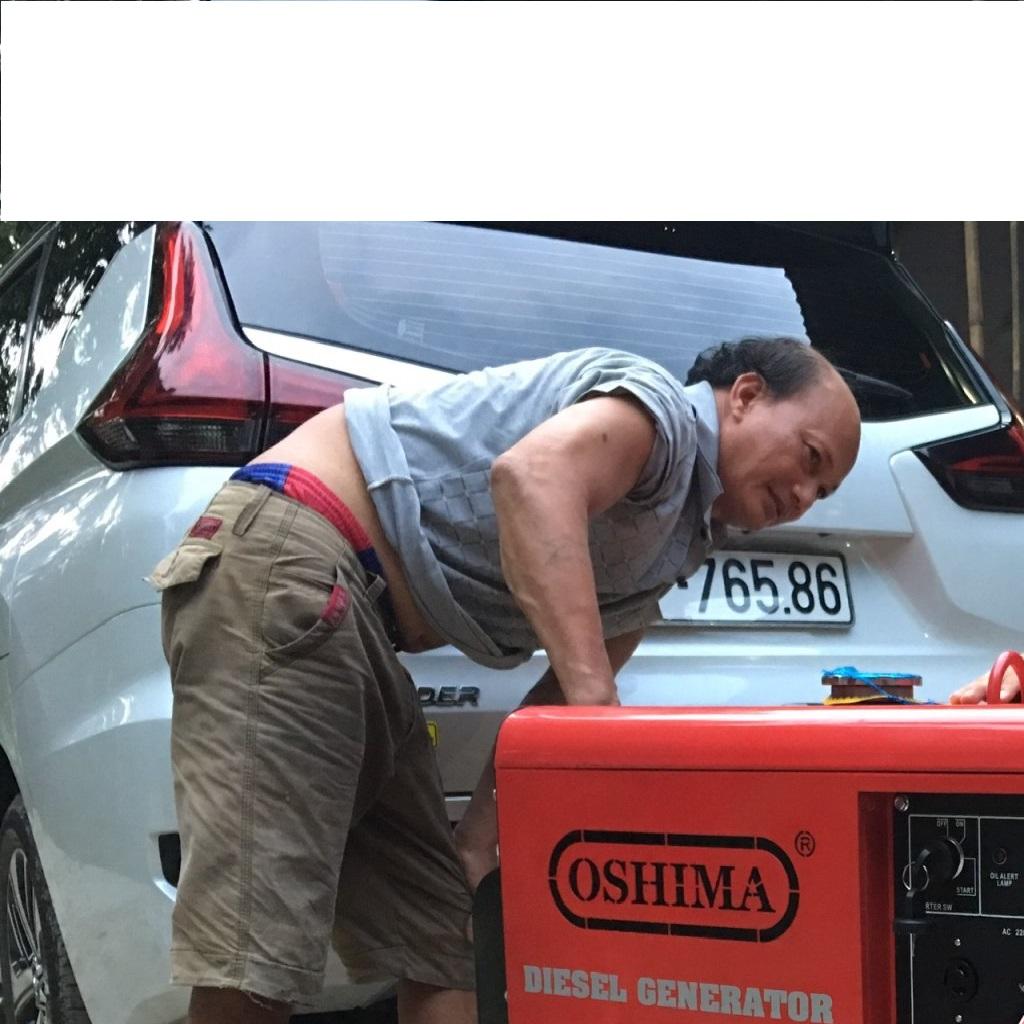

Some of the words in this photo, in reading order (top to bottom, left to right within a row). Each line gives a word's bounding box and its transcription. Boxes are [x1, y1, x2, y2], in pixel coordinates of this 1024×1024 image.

[417, 686, 480, 707] DER
[568, 857, 776, 913] OSHIMA
[925, 902, 942, 911] RTER
[1002, 928, 1012, 936] AC
[523, 965, 628, 1003] DIESEL
[636, 977, 834, 1024] GENERATOR
